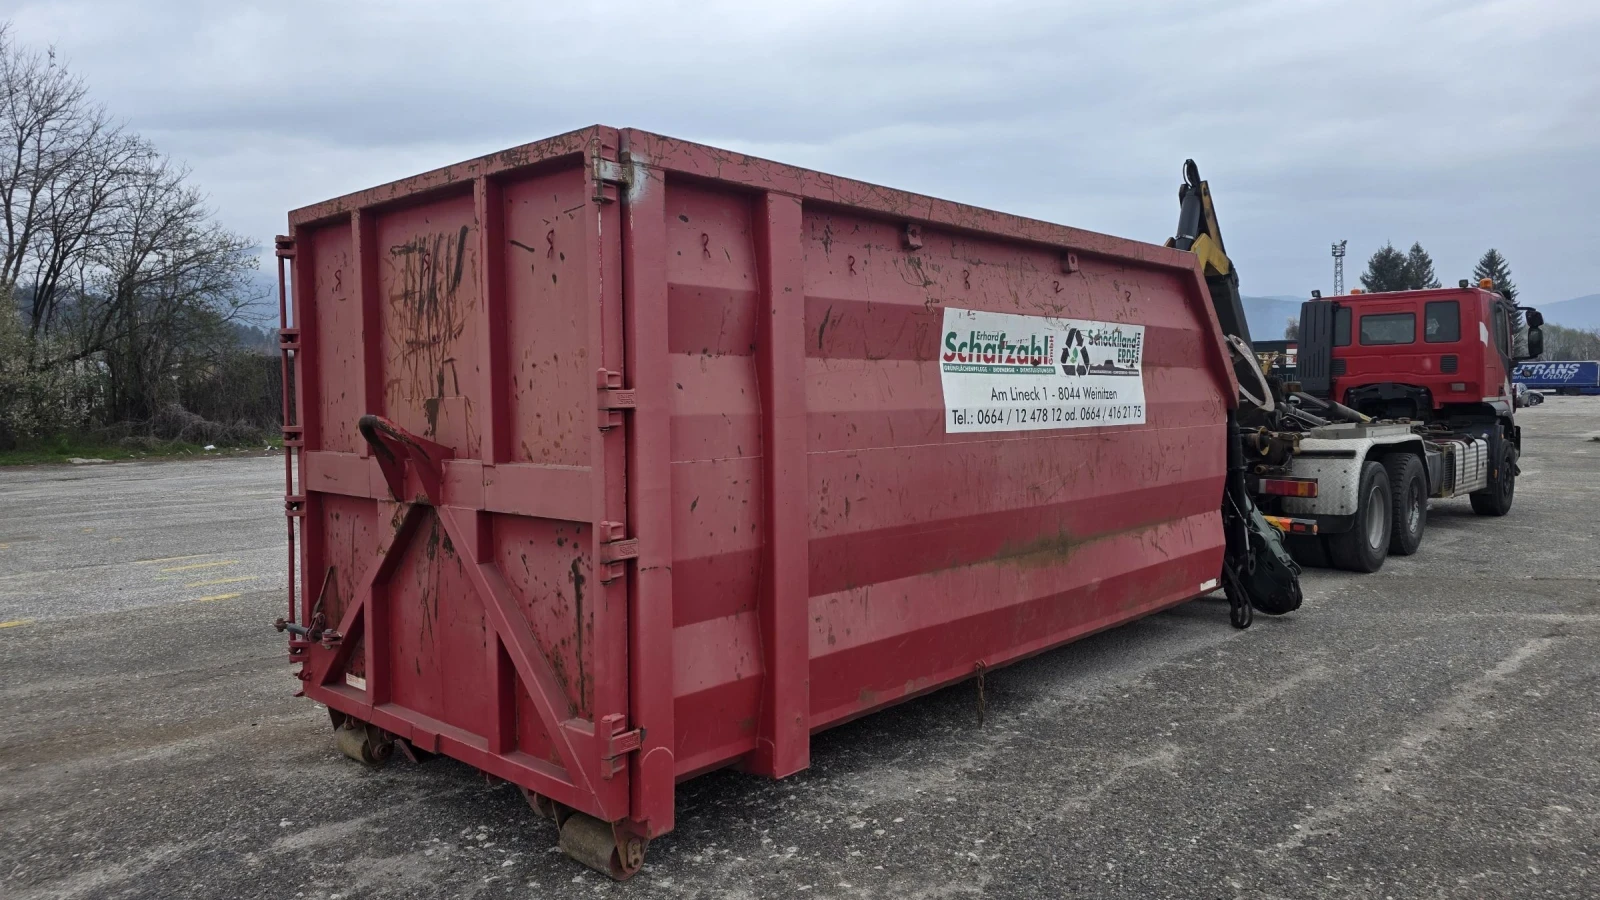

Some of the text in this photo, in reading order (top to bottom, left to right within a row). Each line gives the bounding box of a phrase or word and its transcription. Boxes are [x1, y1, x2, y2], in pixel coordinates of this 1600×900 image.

[976, 331, 999, 341] Erhard
[943, 331, 1049, 365] Schafzahl
[991, 388, 1008, 401] Am
[1010, 387, 1040, 401] Lineck
[1043, 387, 1048, 400] 1
[1058, 387, 1080, 400] 8044
[1083, 387, 1117, 400] Weinitzen
[952, 409, 973, 425] Tel.:
[977, 408, 1004, 424] 0664
[1016, 408, 1027, 423] 12
[1030, 408, 1048, 422] 478
[1051, 407, 1062, 422] 12
[1065, 407, 1077, 421] od.
[1080, 406, 1100, 420] 0664
[1108, 406, 1121, 420] 416
[1123, 406, 1131, 419] 21
[1133, 406, 1141, 418] 75
